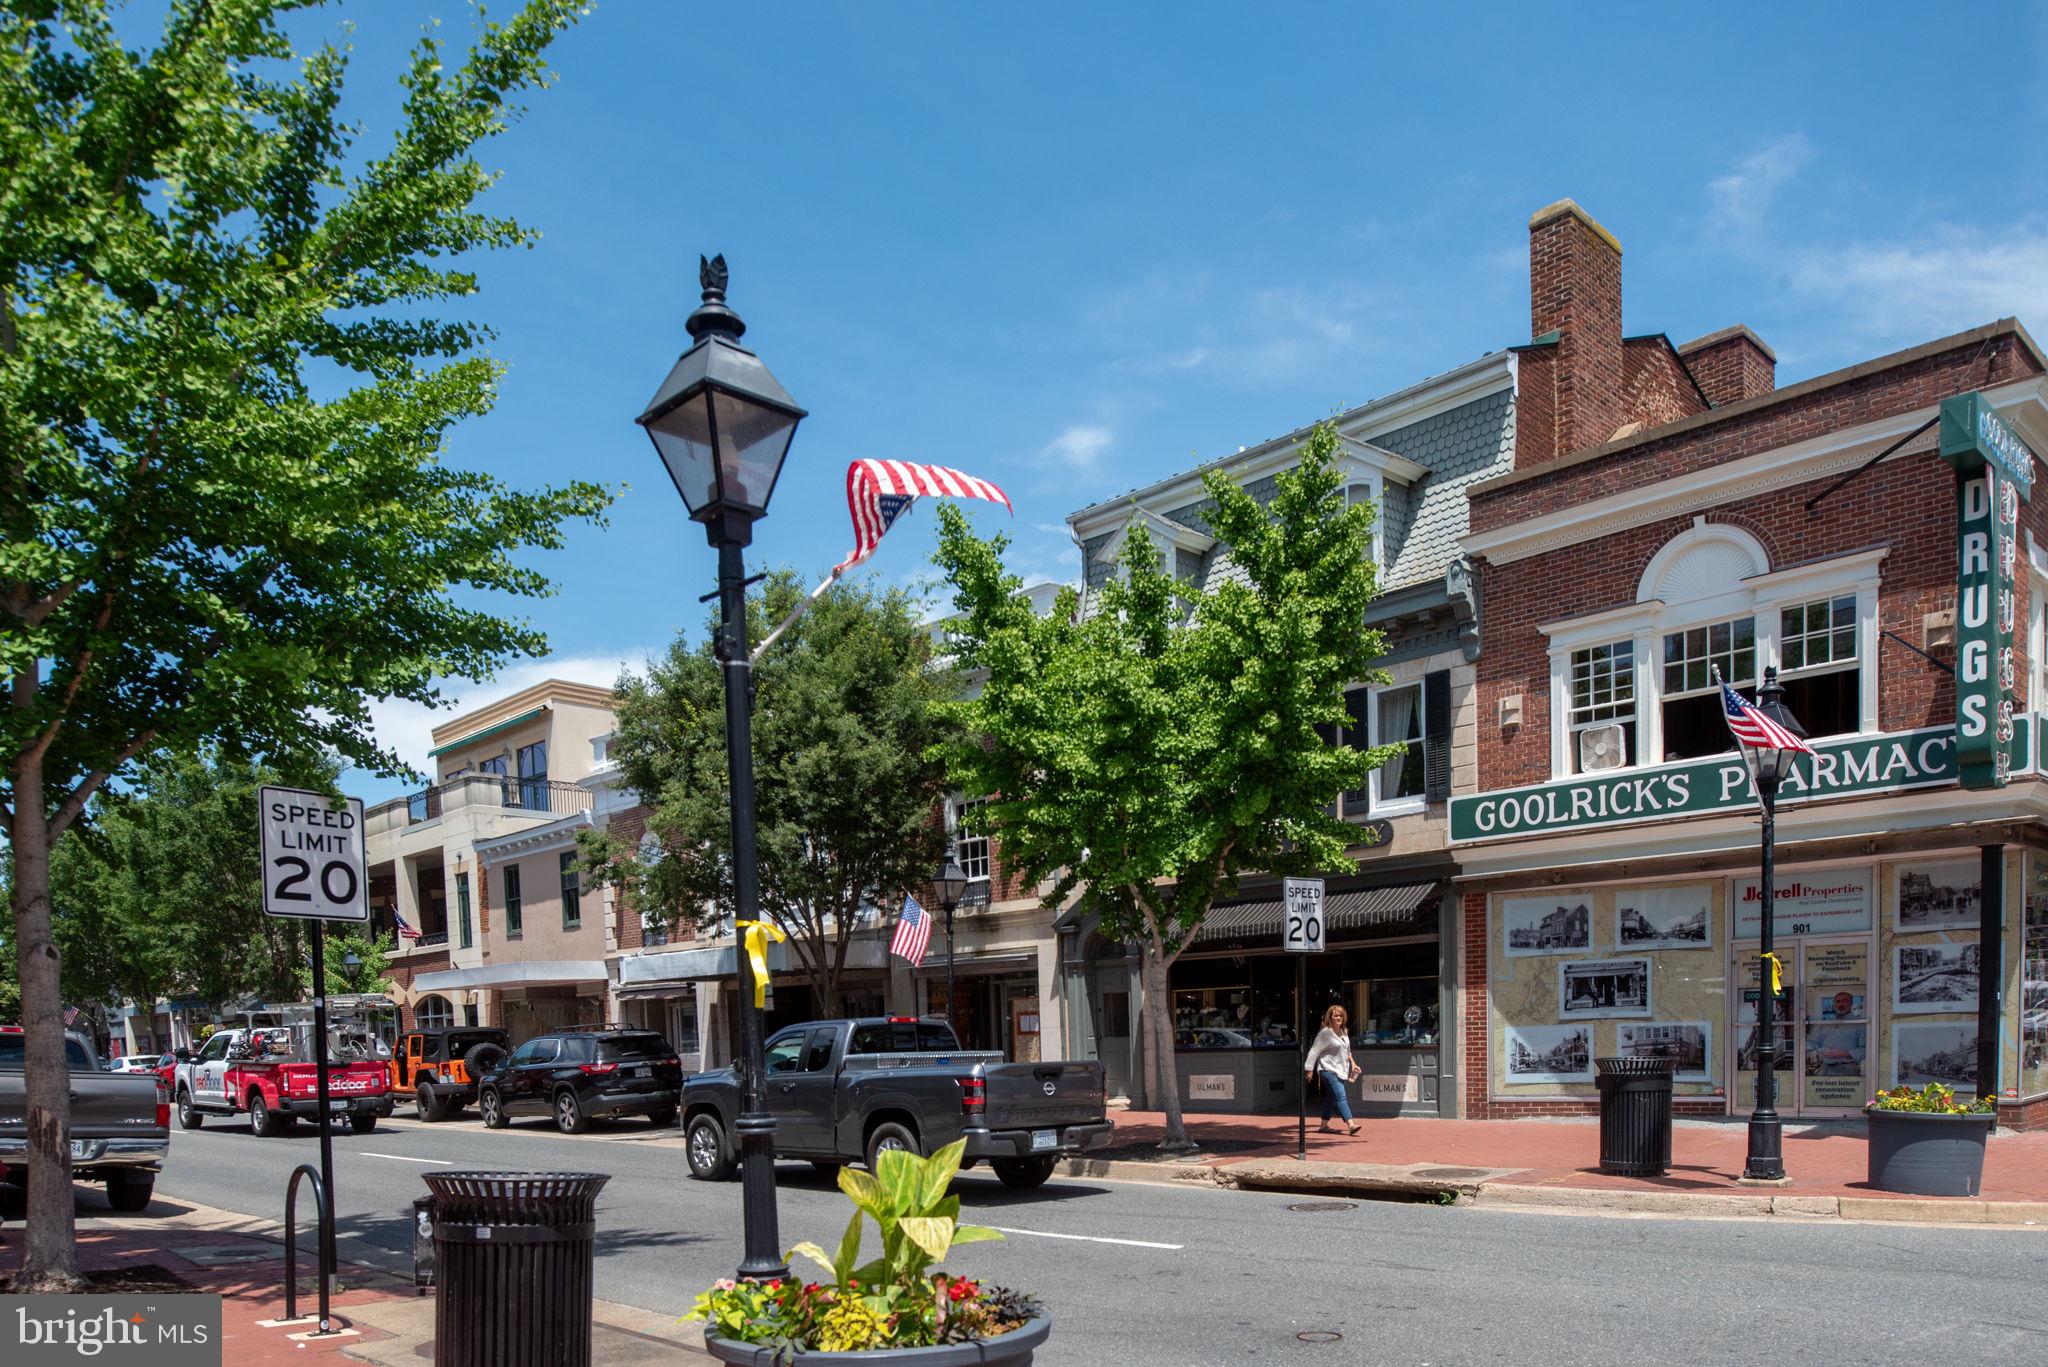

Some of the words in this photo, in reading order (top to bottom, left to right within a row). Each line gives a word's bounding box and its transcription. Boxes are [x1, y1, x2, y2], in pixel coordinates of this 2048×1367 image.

[1962, 480, 1989, 737] DRUGS
[1475, 773, 1690, 831] GOOLRICK'S
[1719, 735, 1957, 801] PARMAC
[272, 803, 355, 829] SPEED
[281, 830, 347, 854] LIMIT
[273, 856, 358, 905] 20
[1288, 887, 1321, 899] SPEED
[1803, 884, 1864, 898] Properties
[1291, 902, 1318, 913] LIMIT
[1288, 916, 1321, 943] 20
[1792, 923, 1811, 934] 901
